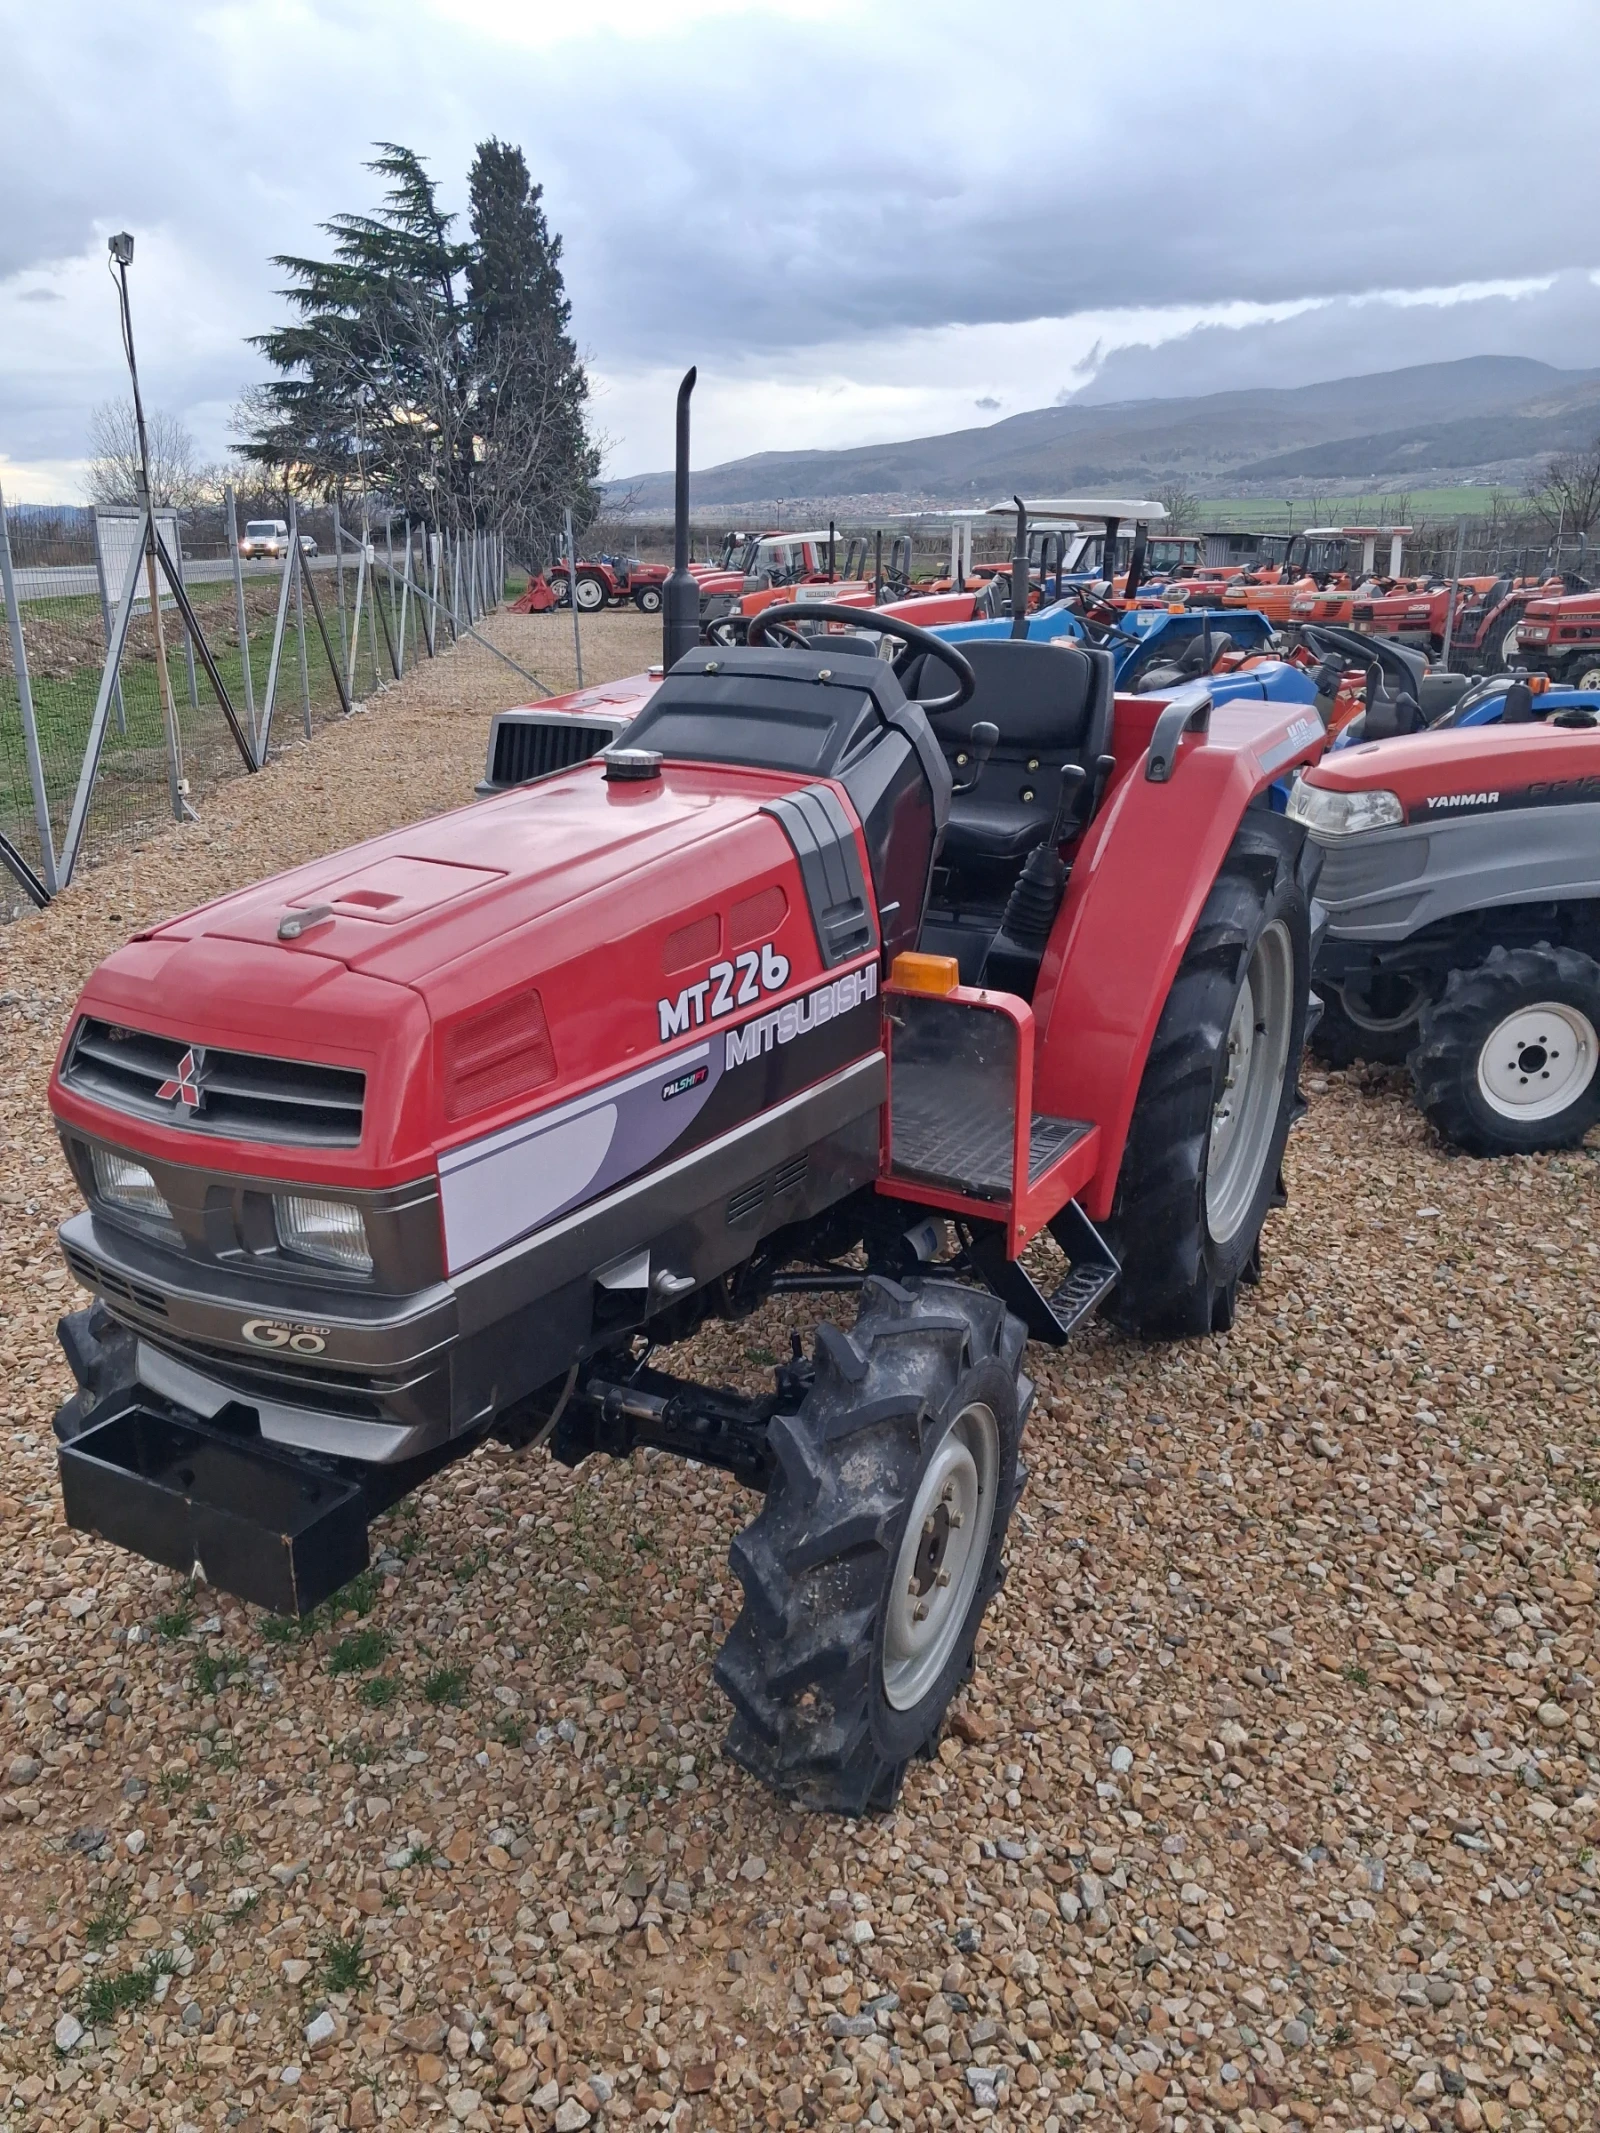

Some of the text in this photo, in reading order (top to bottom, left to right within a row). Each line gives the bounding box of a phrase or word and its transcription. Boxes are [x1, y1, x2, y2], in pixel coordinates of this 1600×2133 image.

[1426, 791, 1500, 809] YANMAR
[657, 942, 790, 1041] MT226
[725, 963, 878, 1072] MITSUBISHI
[663, 1068, 707, 1099] PALSHIFT
[272, 1320, 331, 1335] PALCEED
